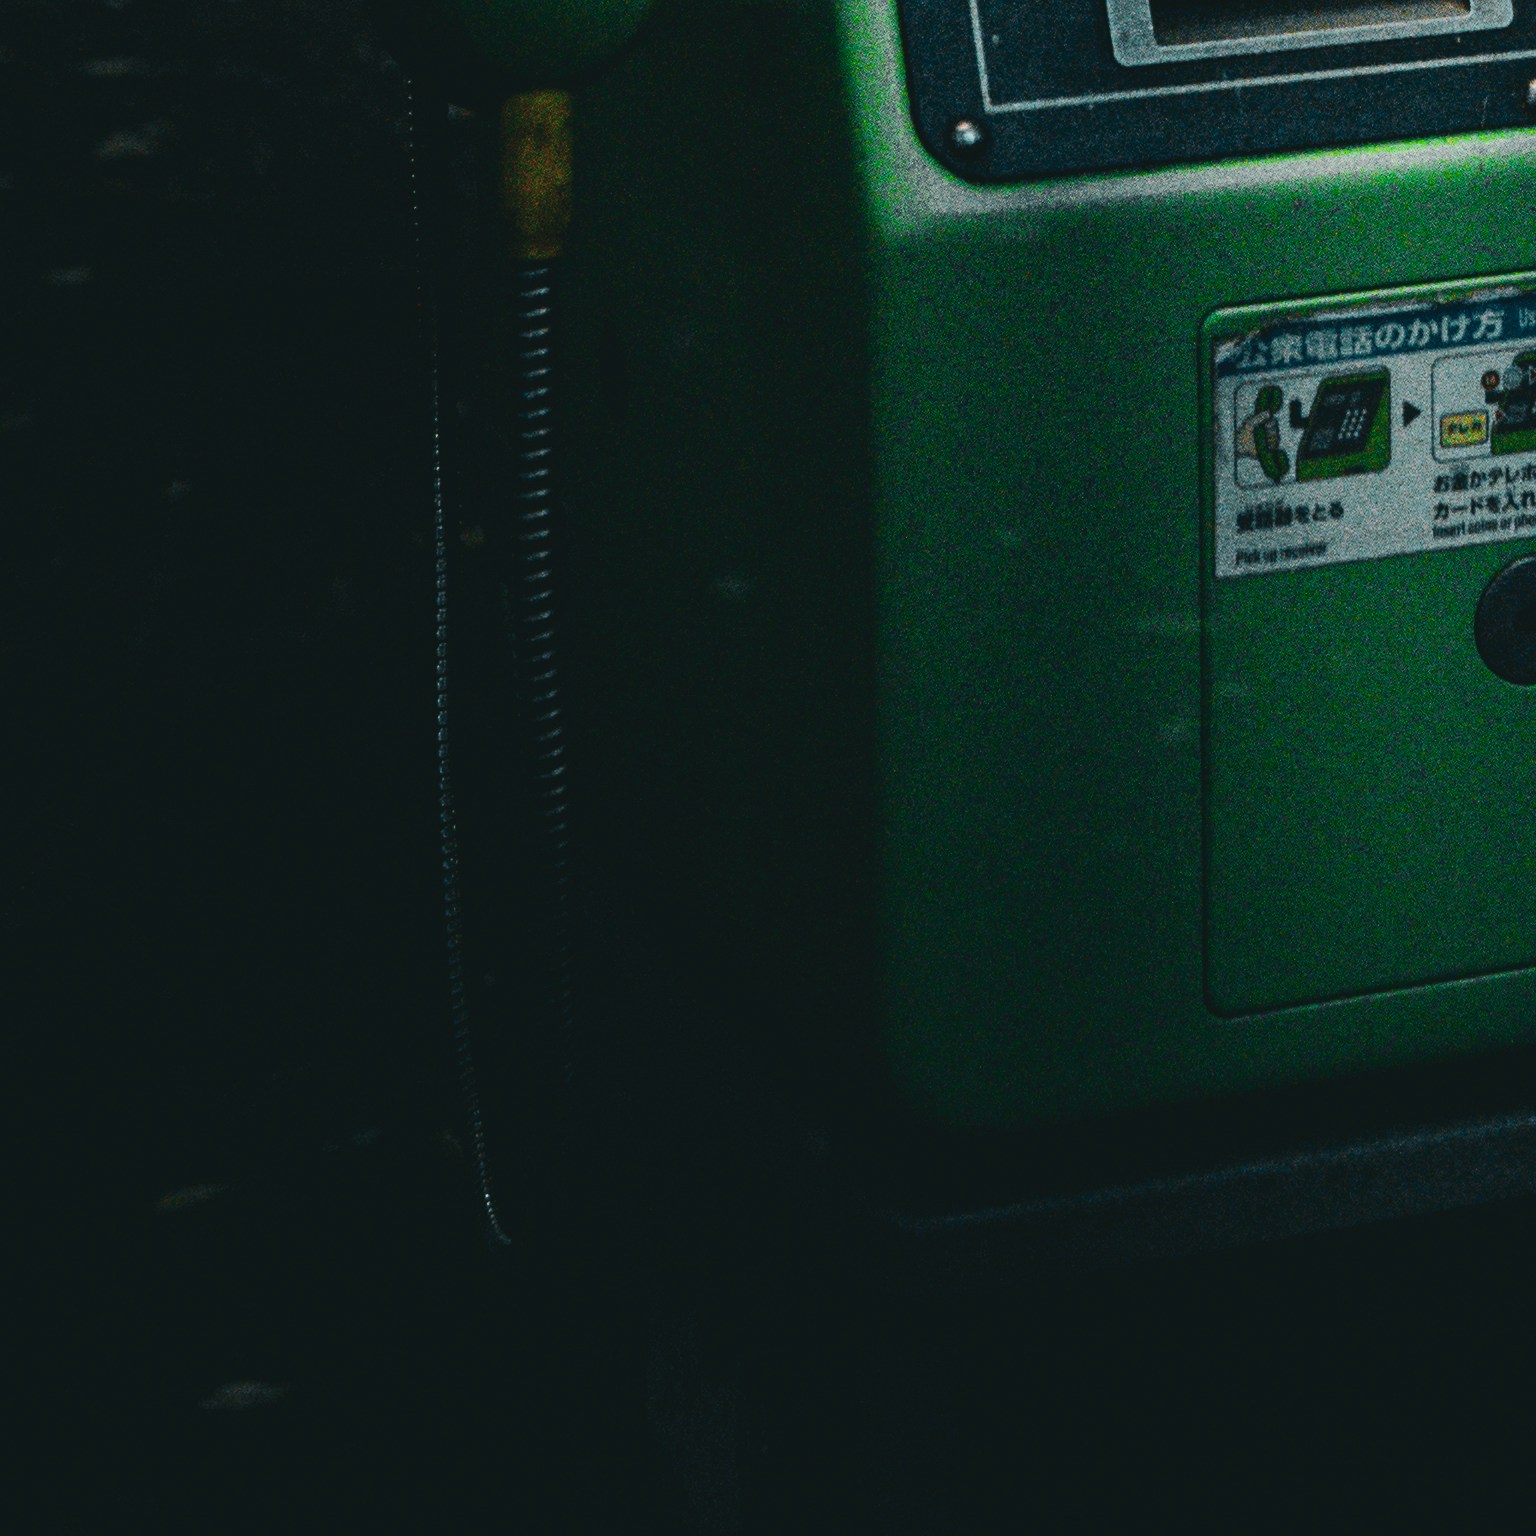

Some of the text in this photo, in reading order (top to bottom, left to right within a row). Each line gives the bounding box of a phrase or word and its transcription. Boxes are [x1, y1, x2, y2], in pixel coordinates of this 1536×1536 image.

[1236, 309, 1505, 369] 公衆電話のかけ方
